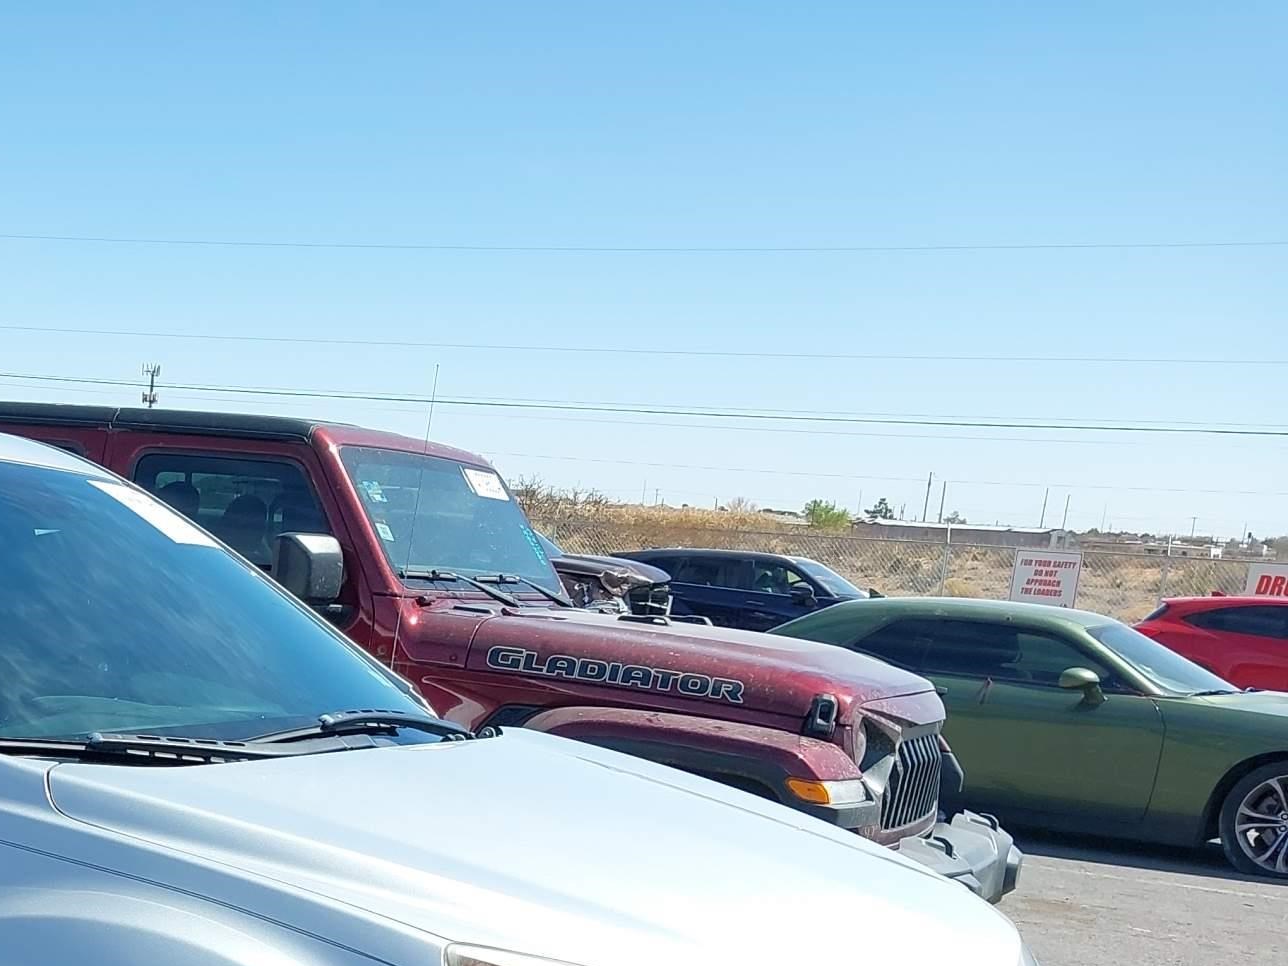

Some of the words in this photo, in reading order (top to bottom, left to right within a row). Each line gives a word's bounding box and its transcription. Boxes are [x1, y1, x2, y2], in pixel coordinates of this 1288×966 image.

[1034, 569, 1044, 577] DO
[1026, 578, 1061, 587] APPROACH
[1033, 588, 1062, 596] LOADERS
[486, 645, 745, 703] GLADIATOR
